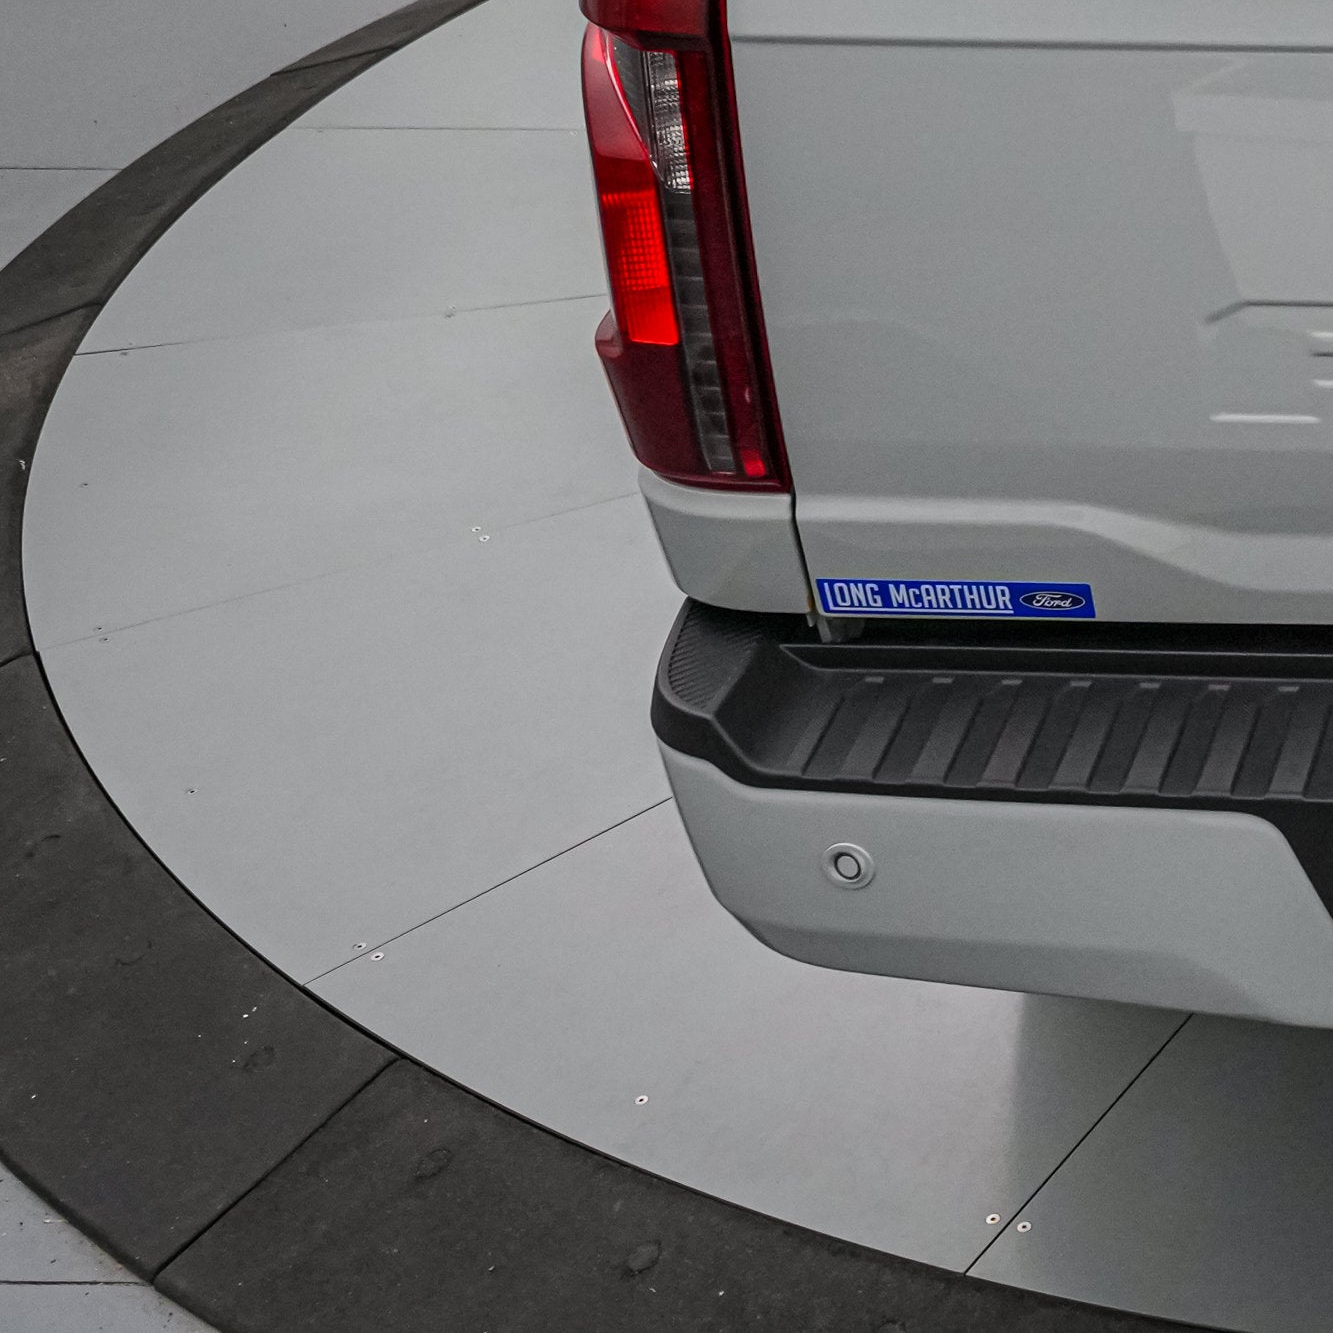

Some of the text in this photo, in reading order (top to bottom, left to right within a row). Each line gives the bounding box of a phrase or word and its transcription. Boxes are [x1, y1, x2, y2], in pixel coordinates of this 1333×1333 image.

[823, 582, 1013, 611] LONG McARTHUR
[1031, 593, 1073, 608] Ford
